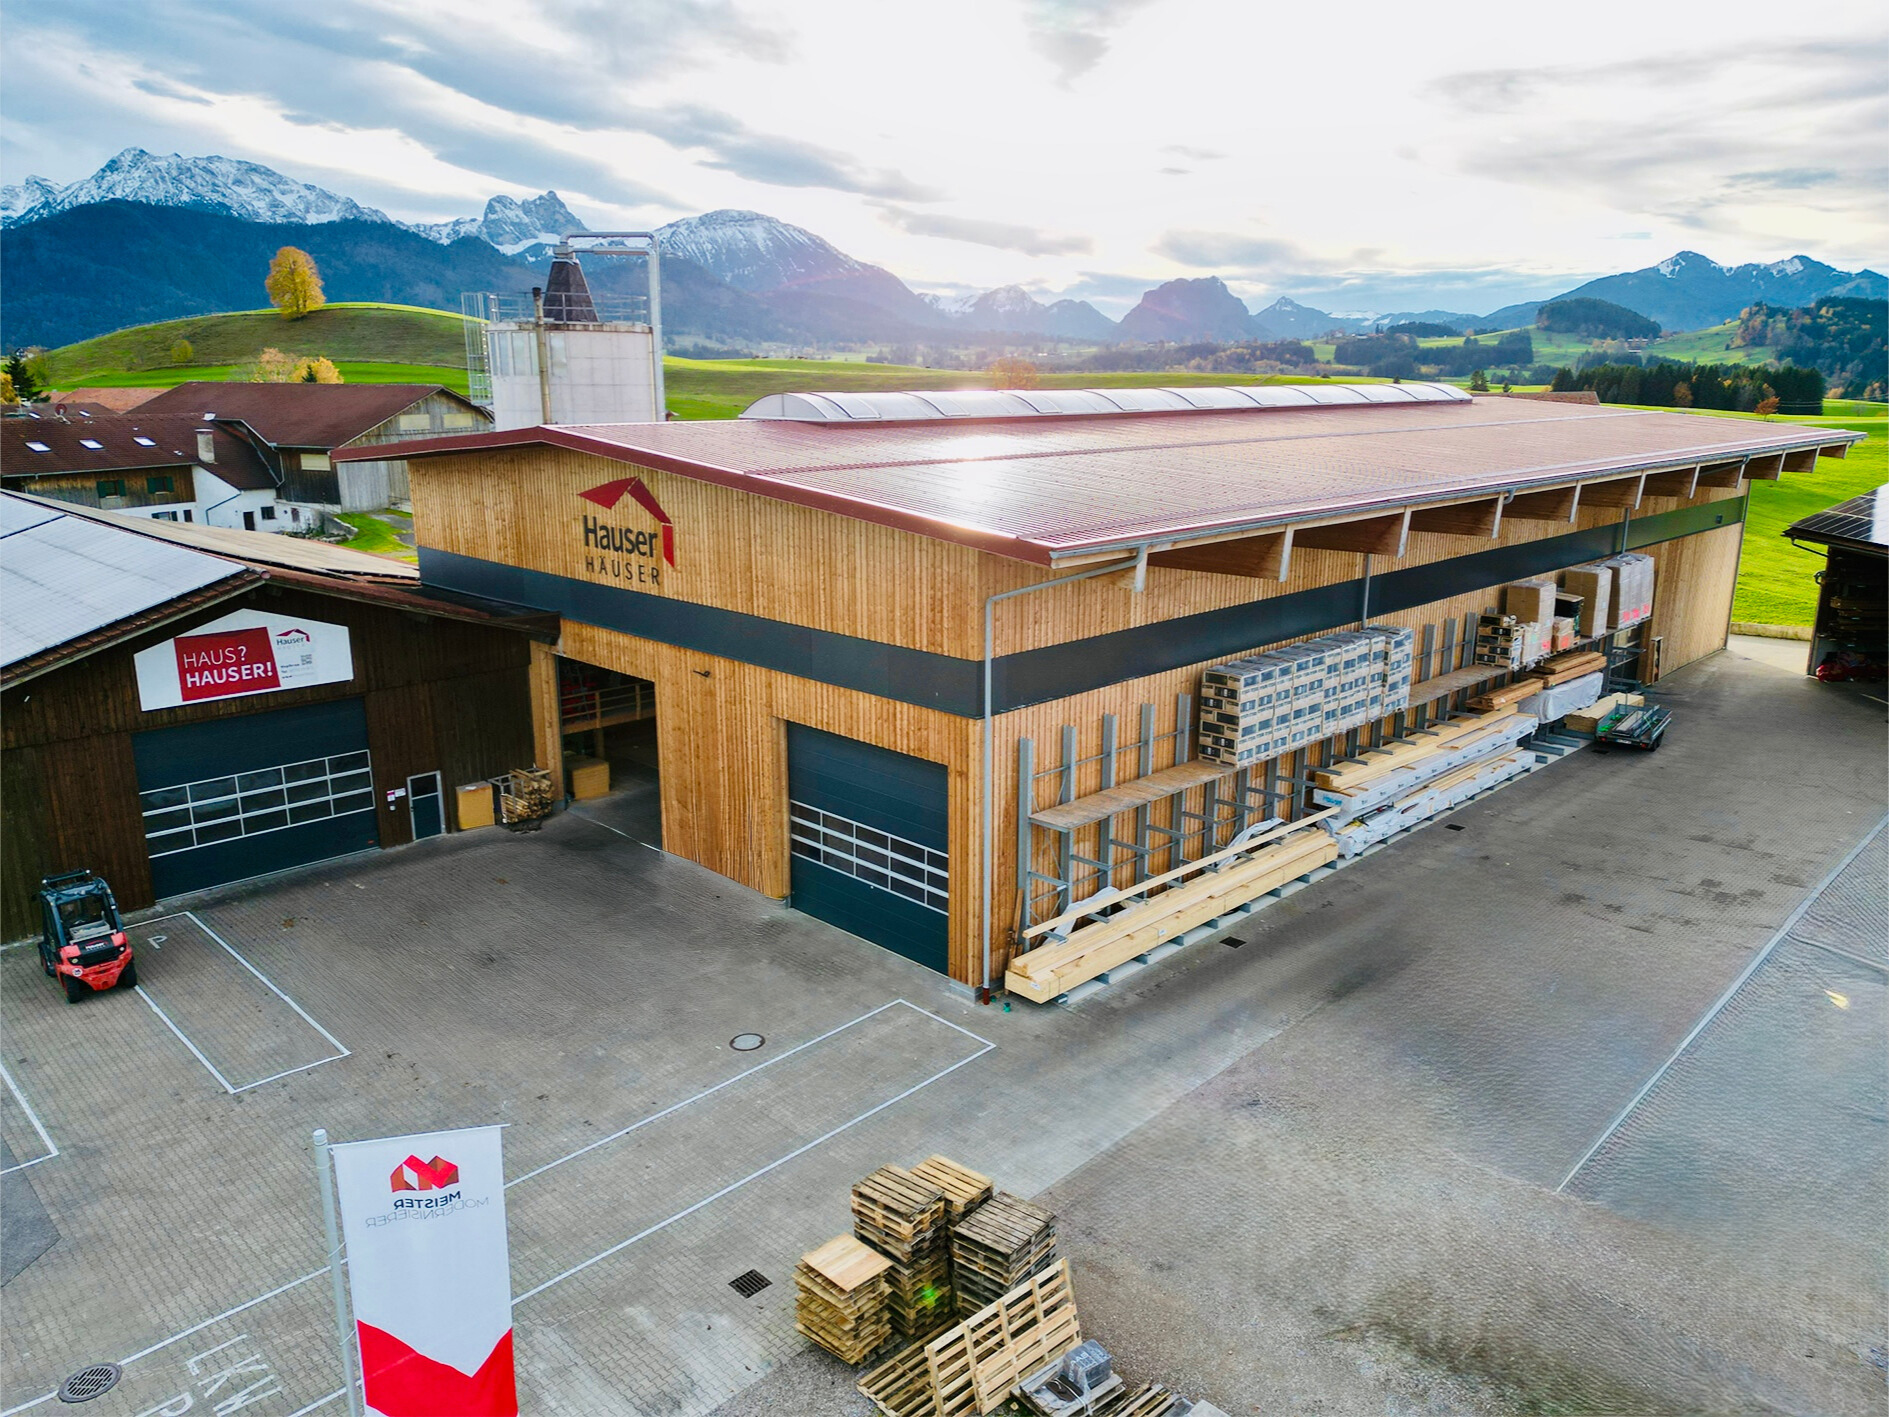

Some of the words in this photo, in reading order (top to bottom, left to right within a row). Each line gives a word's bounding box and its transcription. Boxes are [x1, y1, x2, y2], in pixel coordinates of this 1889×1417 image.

[583, 514, 658, 558] Hauser
[585, 555, 660, 586] HÄUSER
[276, 636, 305, 646] Hauser
[183, 645, 247, 669] HAUS?
[186, 661, 273, 688] HAUSER!
[146, 935, 168, 950] P
